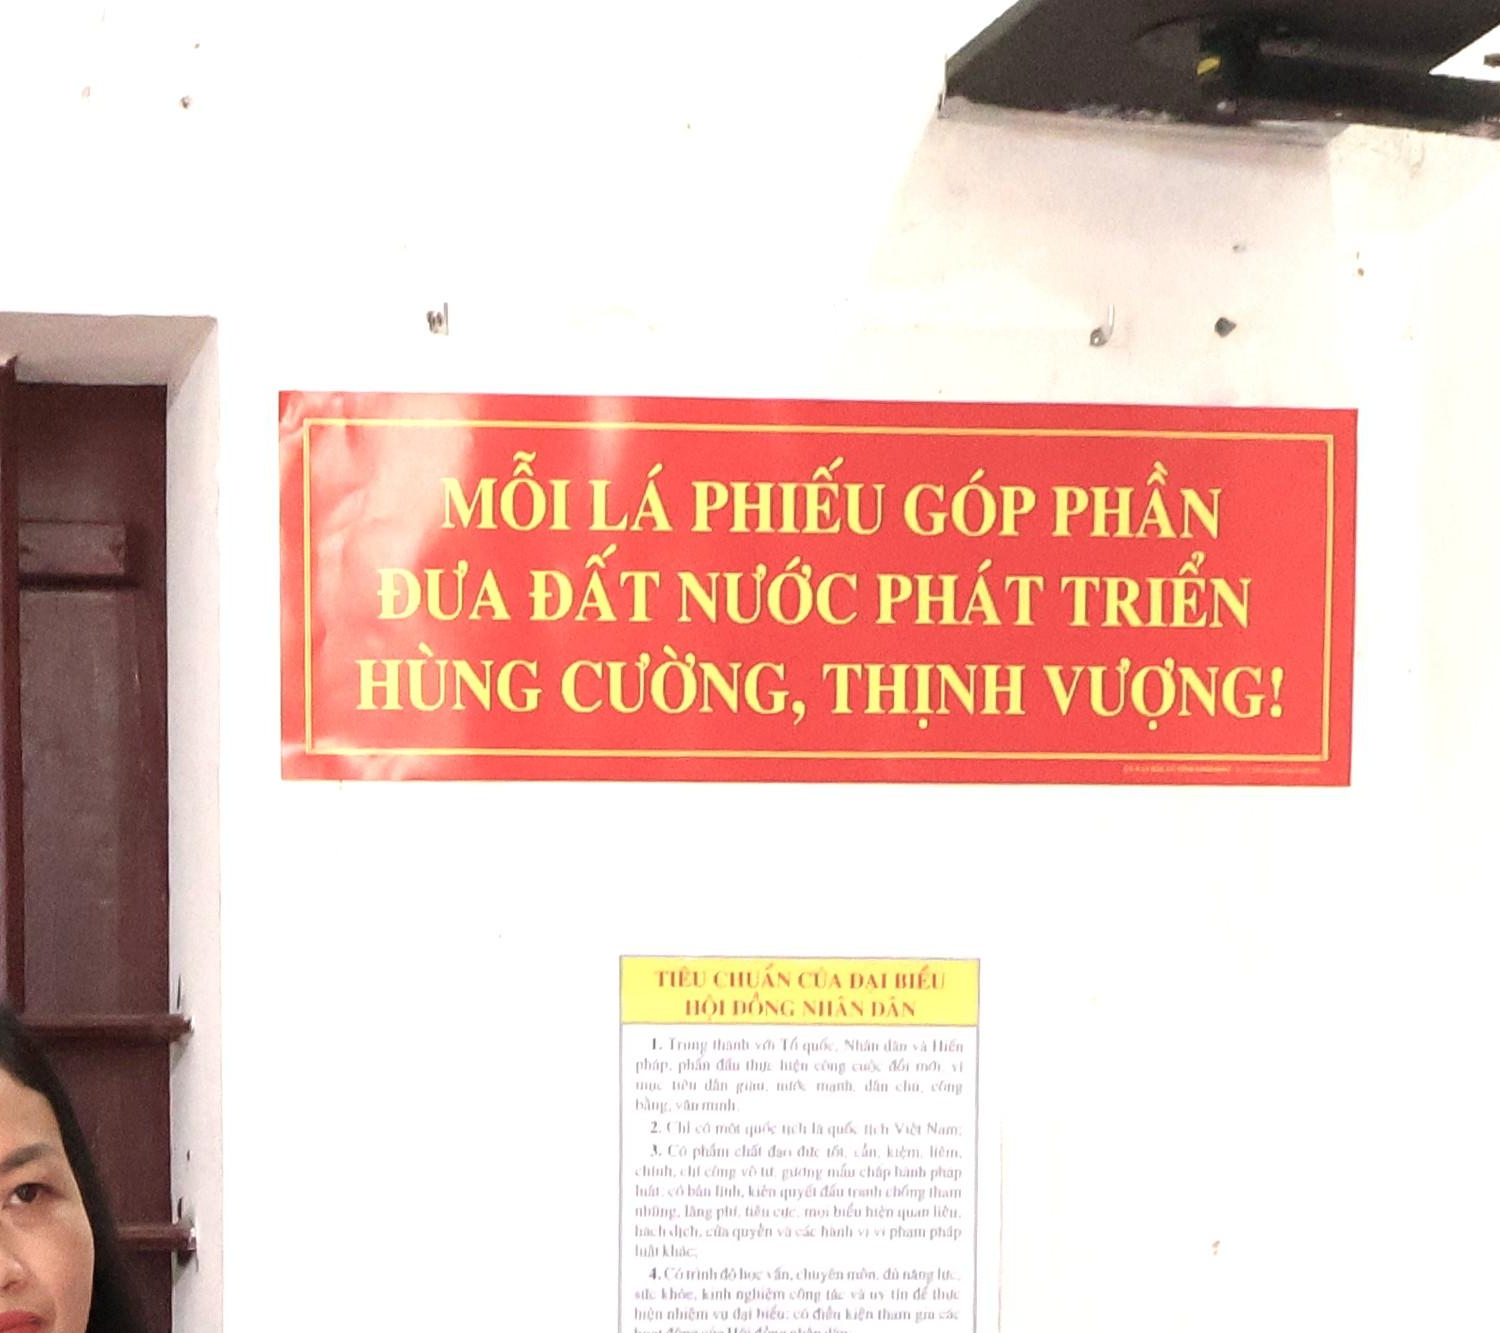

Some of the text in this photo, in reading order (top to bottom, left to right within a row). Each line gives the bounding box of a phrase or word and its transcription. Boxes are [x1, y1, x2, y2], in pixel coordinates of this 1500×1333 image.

[443, 450, 1222, 539] MỖI LÁ PHIẾU GÓP PHẦN
[377, 543, 1252, 629] ĐƯA ĐẤT NƯỚC PHÁT TRIỂN
[356, 643, 1285, 731] HÙNG CƯỜNG, THỊNH VƯỢNG!
[803, 996, 864, 1017] NHÂN
[872, 996, 915, 1017] DÂN
